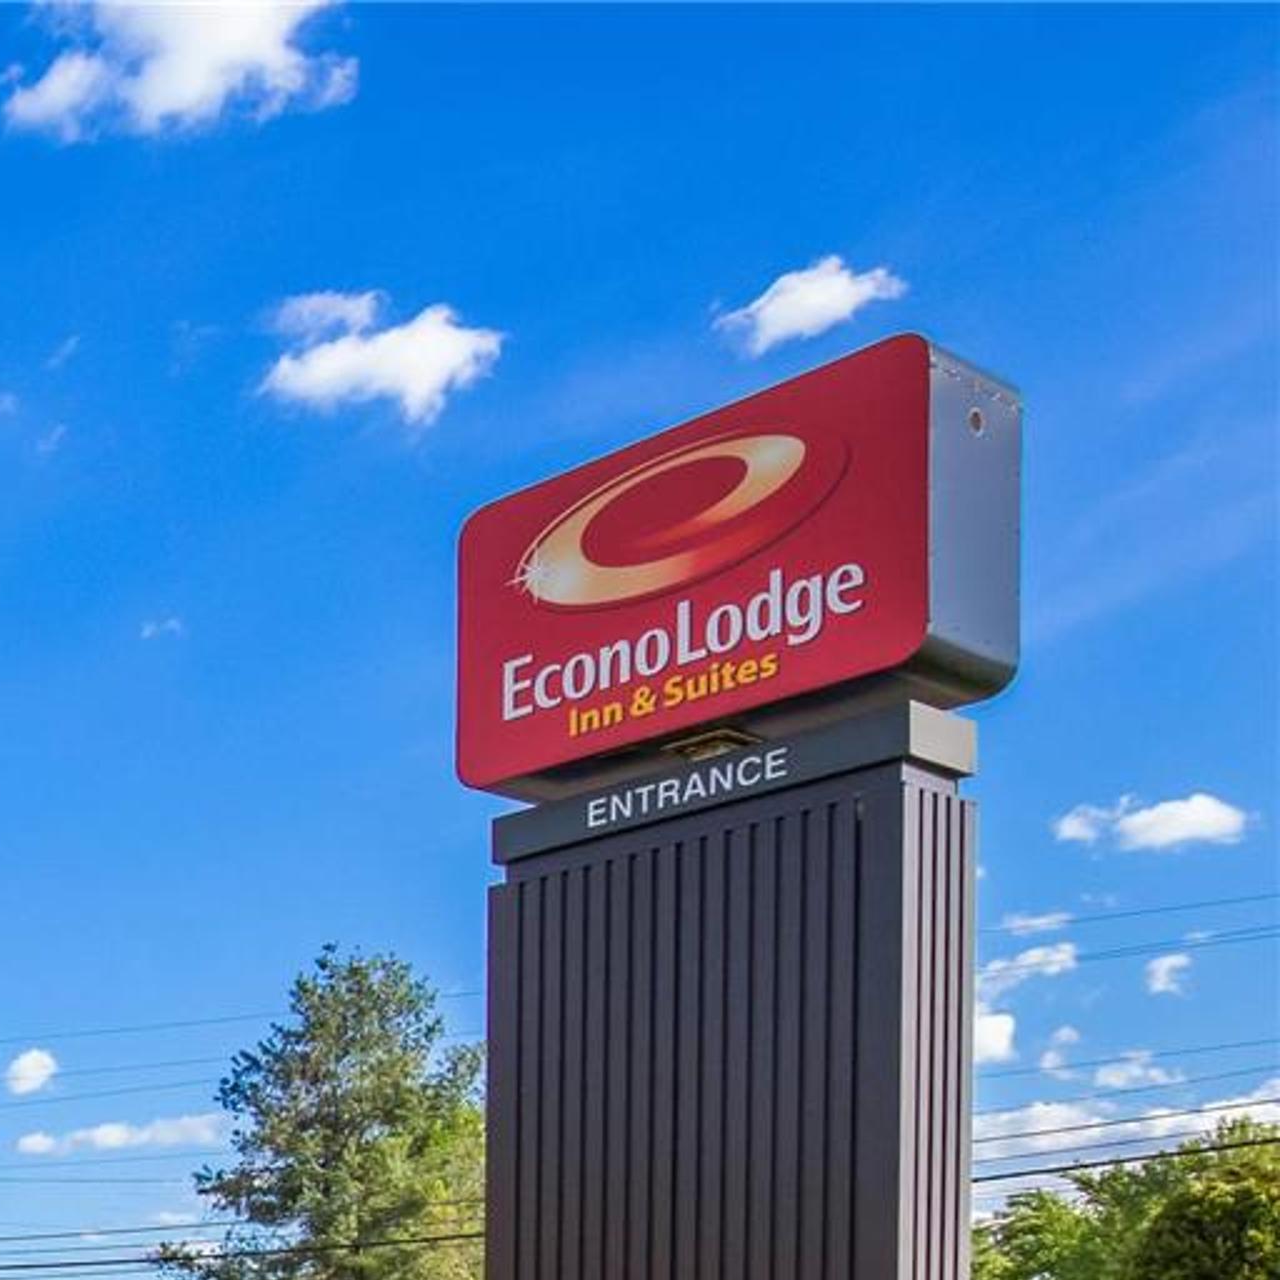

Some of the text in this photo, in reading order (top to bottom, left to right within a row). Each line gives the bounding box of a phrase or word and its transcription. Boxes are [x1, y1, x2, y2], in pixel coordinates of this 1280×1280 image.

[502, 562, 865, 721] EconoLodge
[568, 652, 781, 737] Inn & Suites
[586, 746, 789, 828] ENTRANCE
